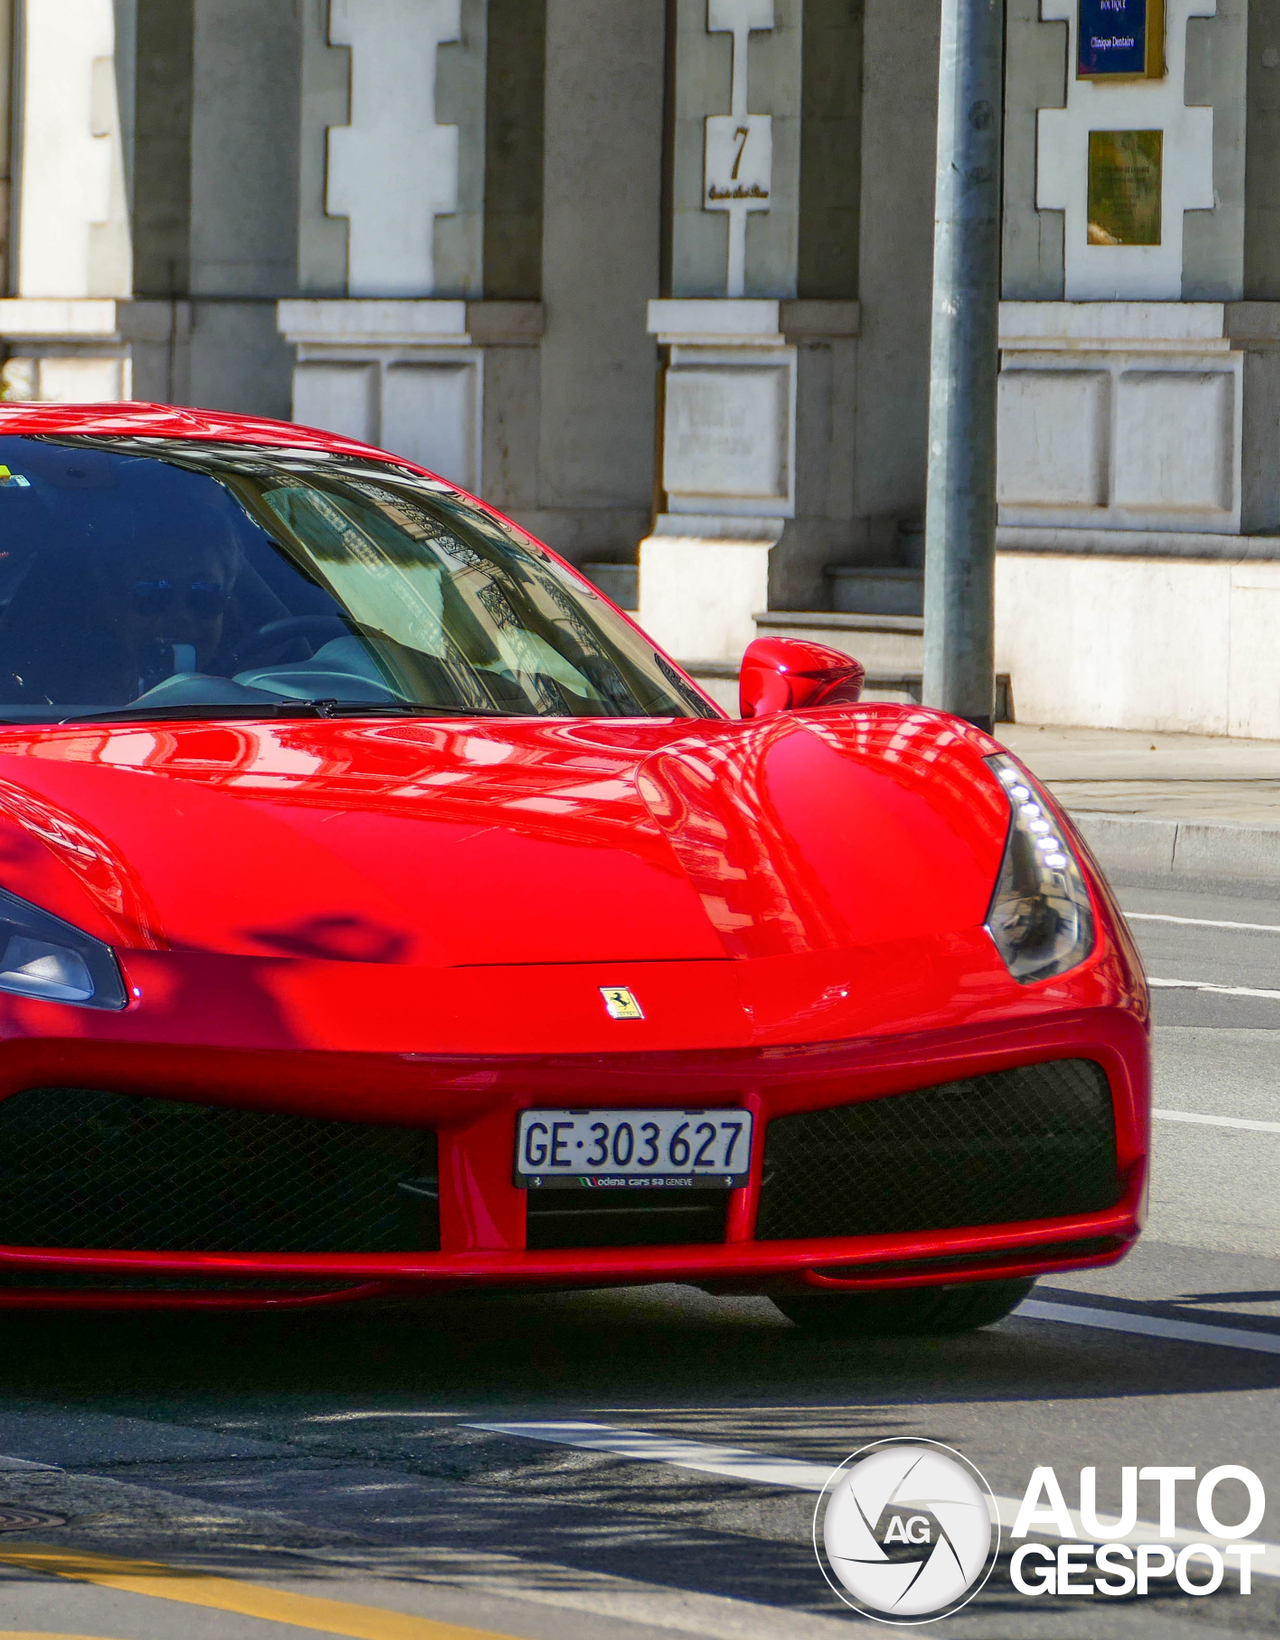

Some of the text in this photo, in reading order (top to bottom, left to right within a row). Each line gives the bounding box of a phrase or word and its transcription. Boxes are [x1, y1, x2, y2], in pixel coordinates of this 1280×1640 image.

[1090, 35, 1135, 50] Clinique Dentaire
[733, 127, 749, 180] 7
[628, 1178, 650, 1187] cars
